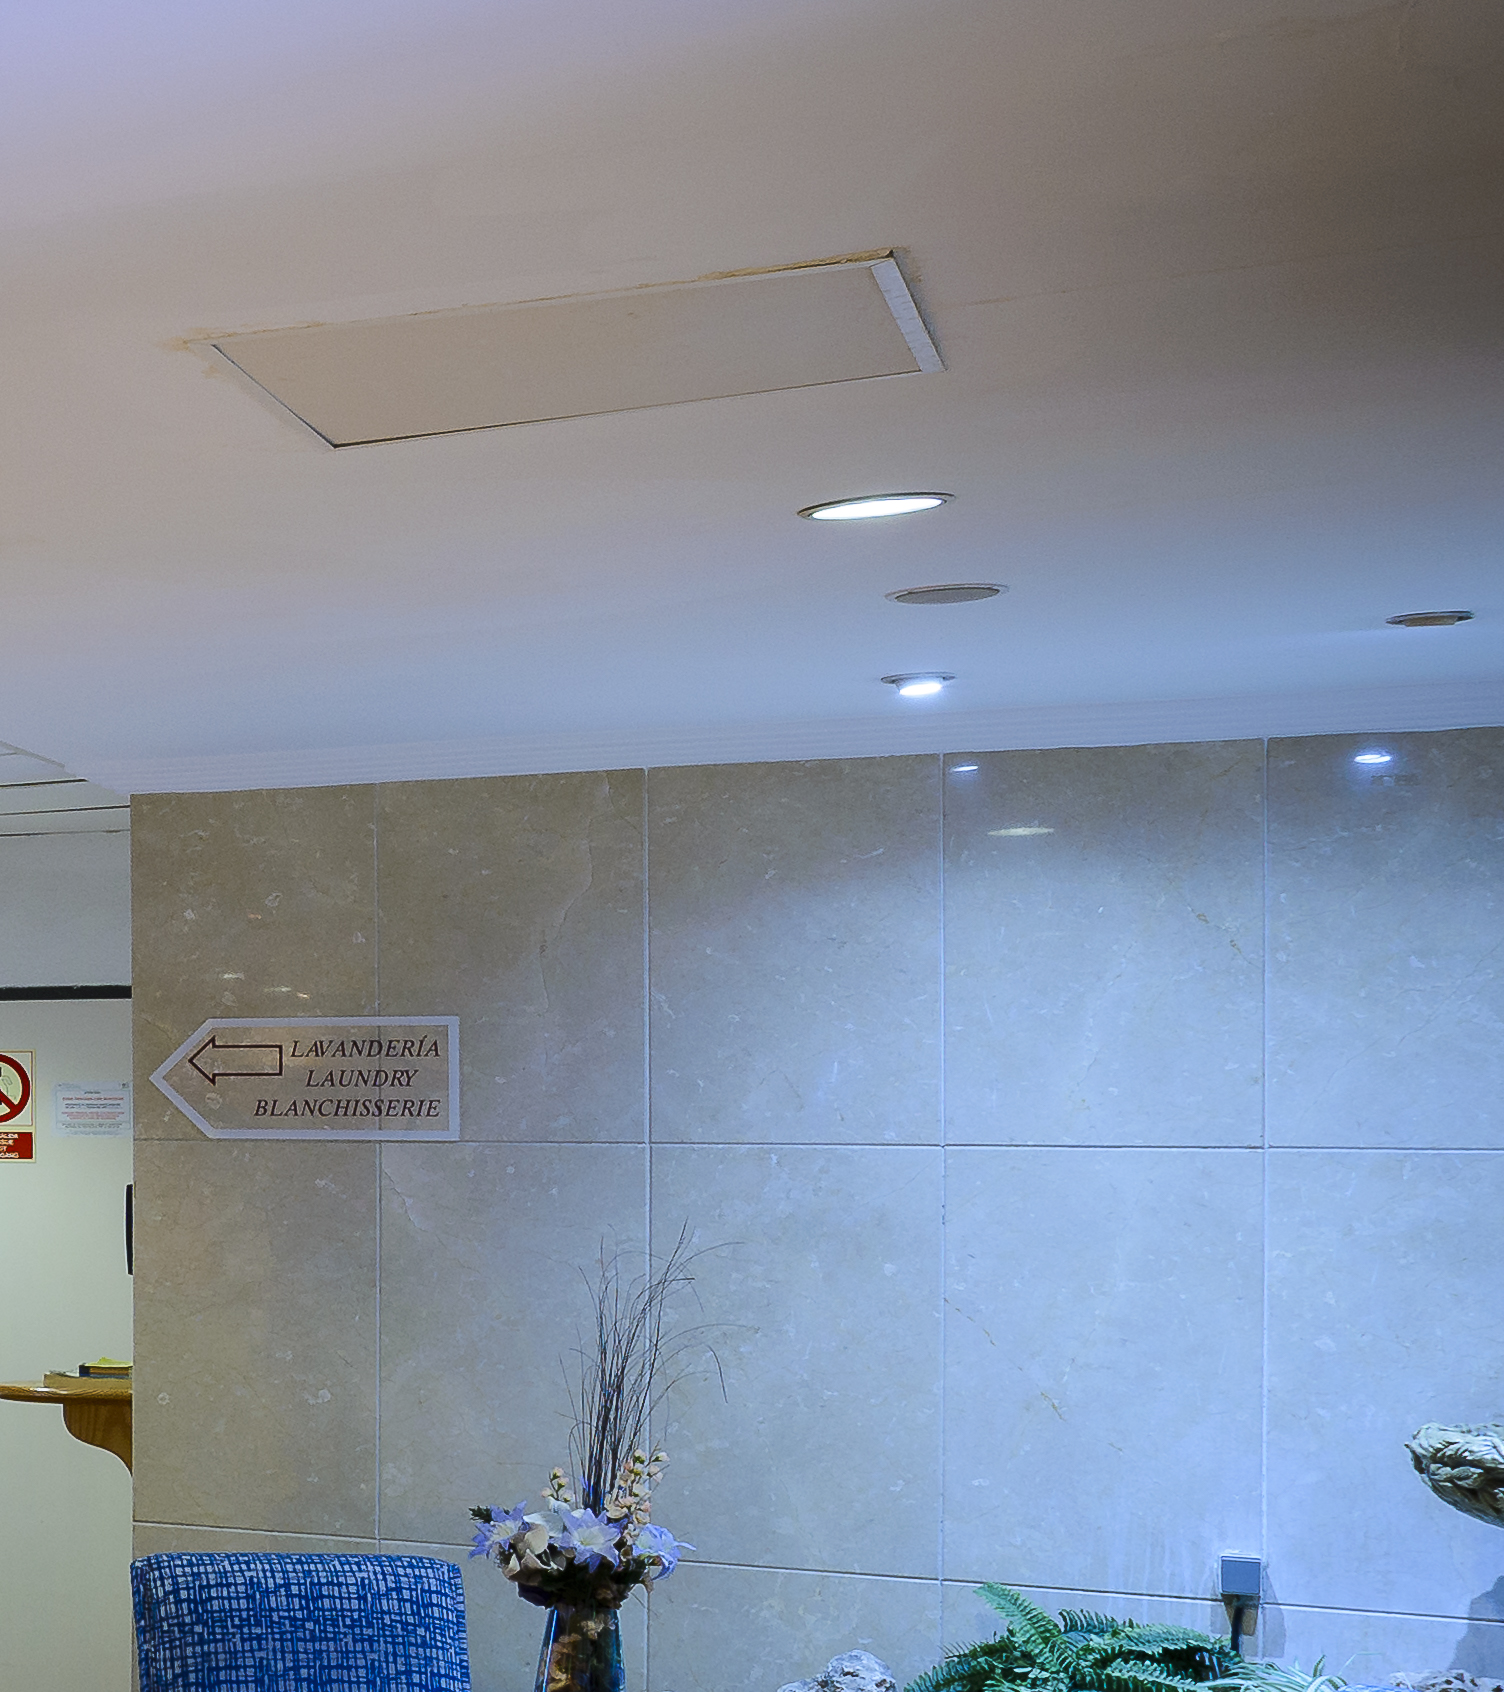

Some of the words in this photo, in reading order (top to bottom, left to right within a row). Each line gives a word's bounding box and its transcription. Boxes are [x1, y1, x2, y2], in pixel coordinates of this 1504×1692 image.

[290, 1035, 440, 1058] LAVANDERÍA
[306, 1069, 419, 1087] LAUNDRY
[254, 1099, 441, 1117] BLANCHISSERIE
